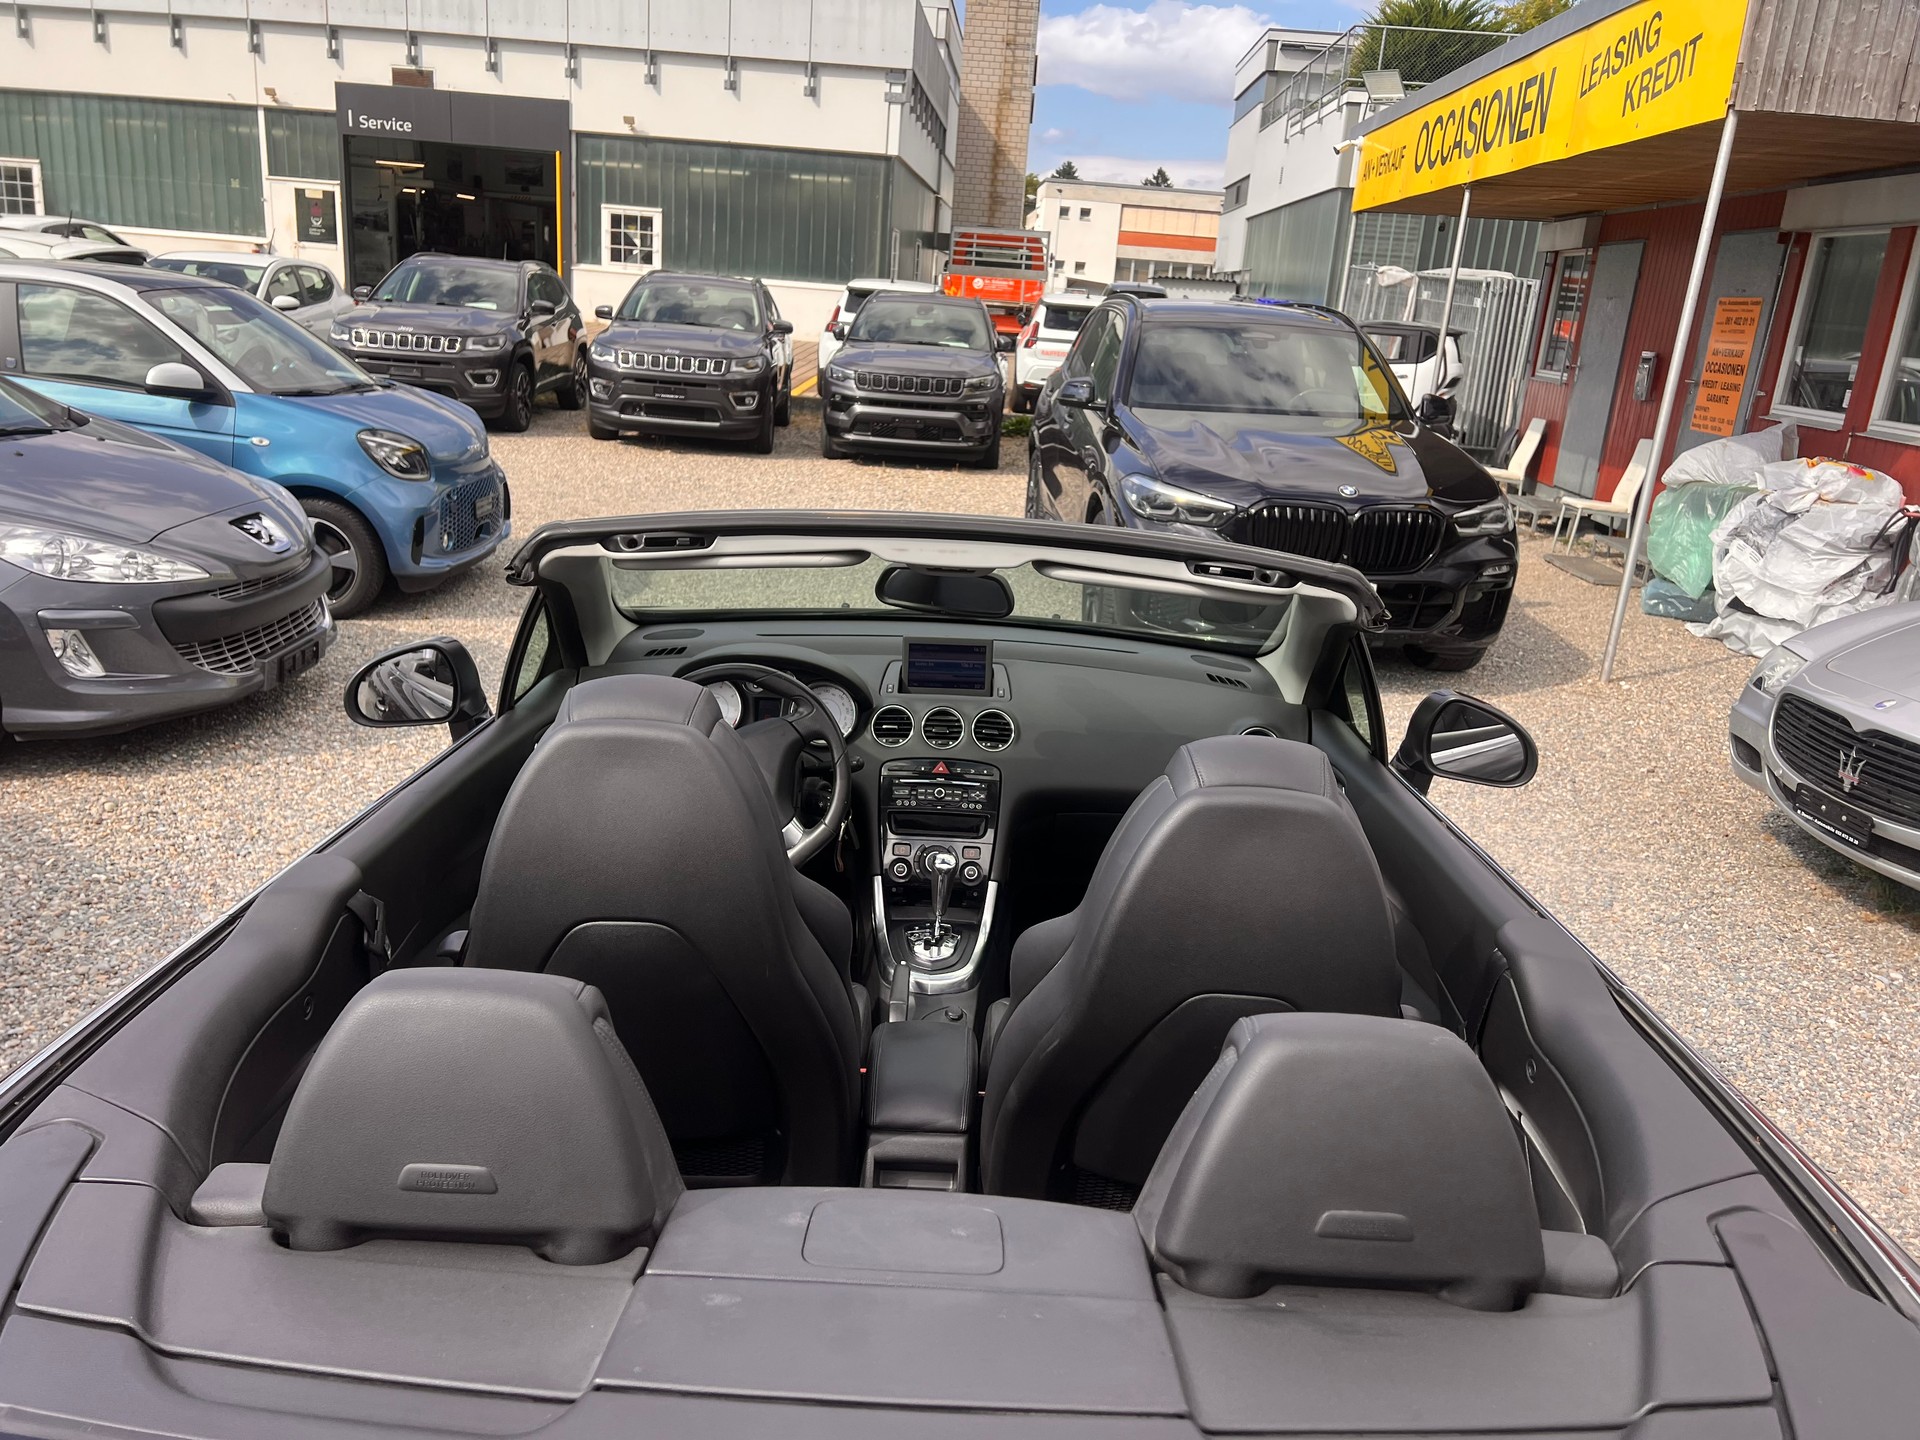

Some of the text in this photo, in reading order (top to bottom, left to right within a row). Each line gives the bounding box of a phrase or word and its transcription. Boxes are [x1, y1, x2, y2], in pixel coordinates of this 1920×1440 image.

[1580, 11, 1662, 99] LEASING
[1622, 32, 1703, 118] KREDIT
[359, 114, 412, 132] Service
[1414, 67, 1557, 174] OCCASIONEN
[1705, 361, 1746, 377] OCCASIONEN
[1701, 379, 1718, 389] KREDIT
[1720, 381, 1742, 393] LEASING
[1706, 393, 1729, 405] GARANTIE
[420, 1171, 471, 1181] ROLLOVER
[416, 1179, 476, 1190] PROTECTION
